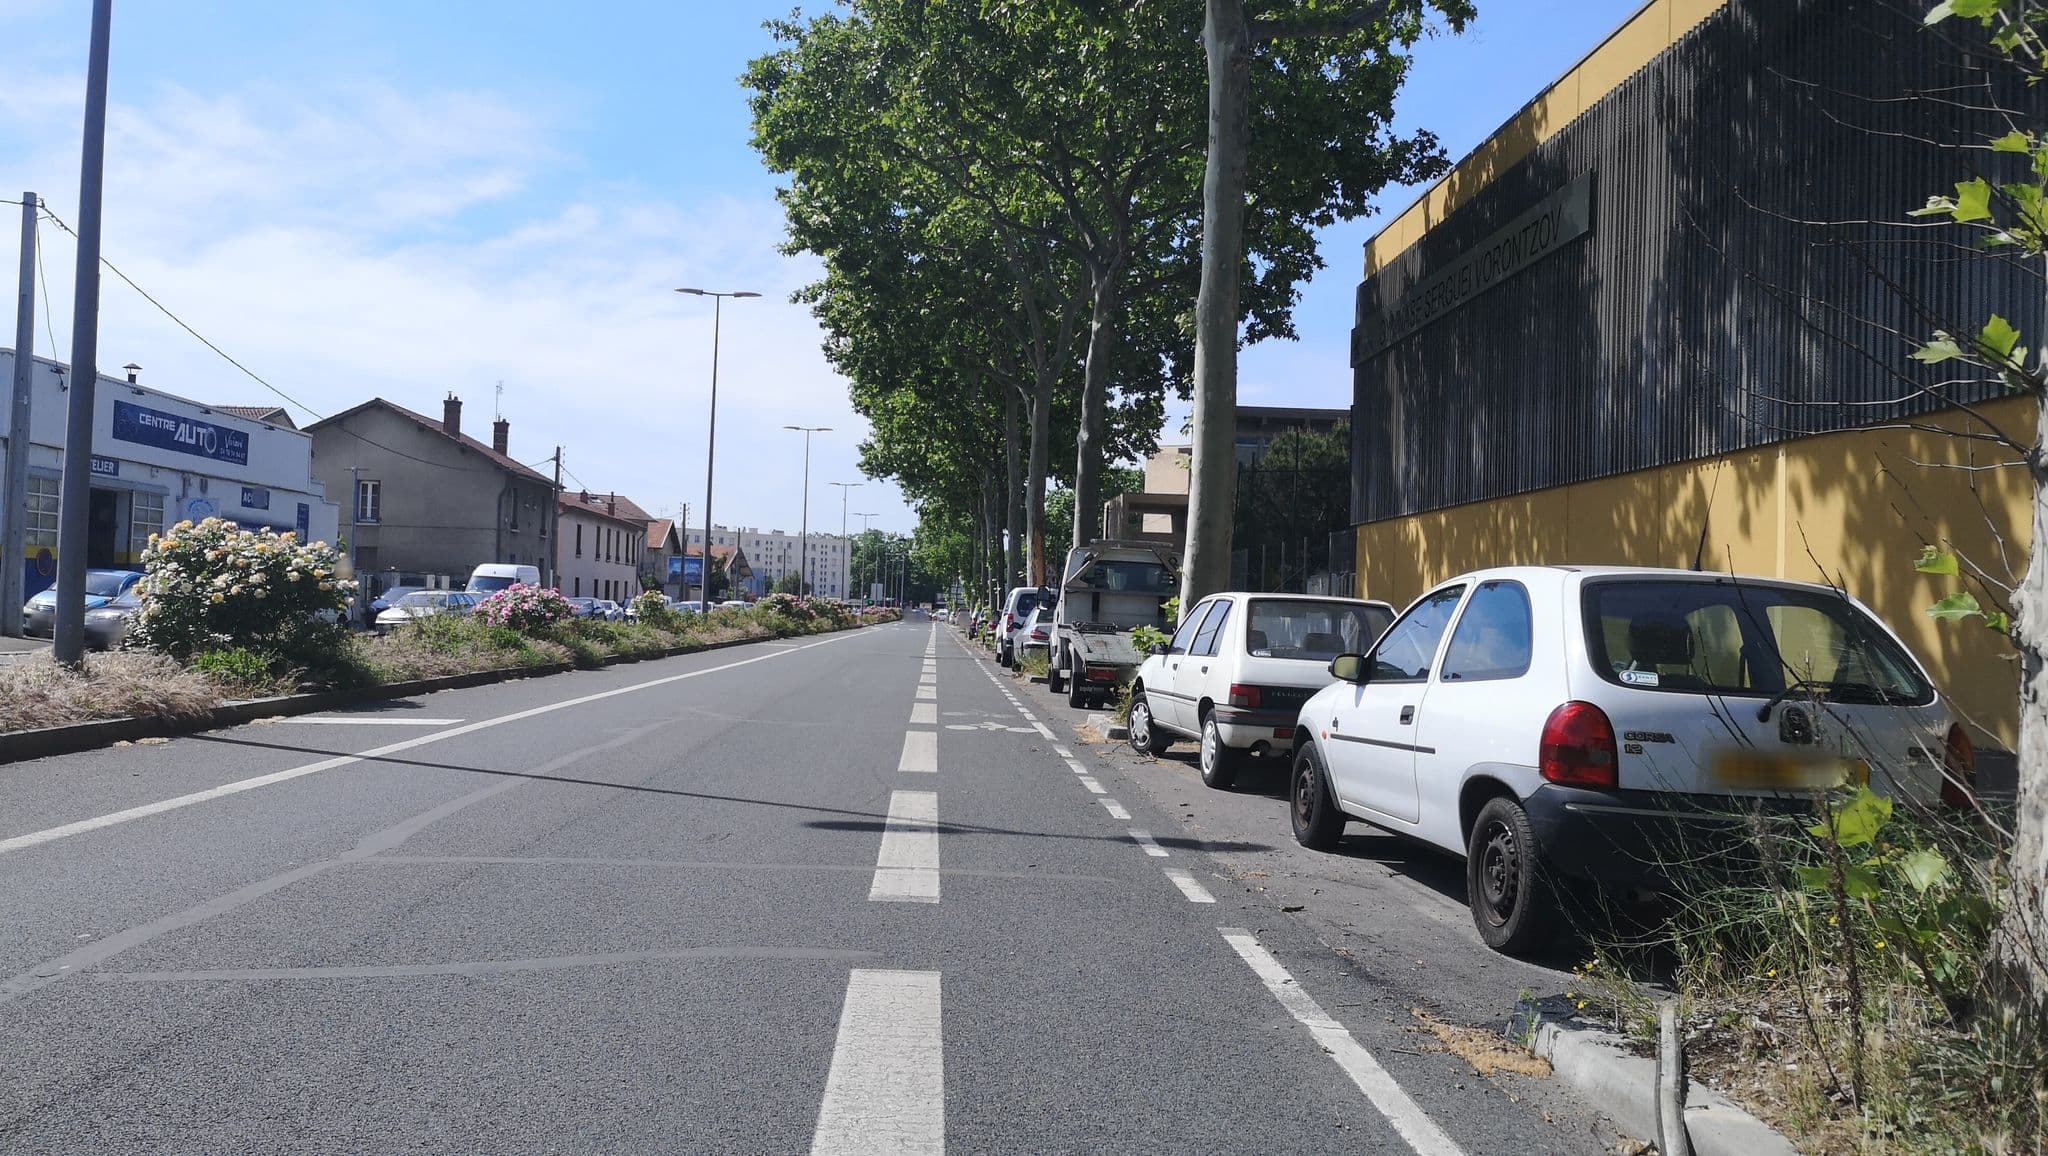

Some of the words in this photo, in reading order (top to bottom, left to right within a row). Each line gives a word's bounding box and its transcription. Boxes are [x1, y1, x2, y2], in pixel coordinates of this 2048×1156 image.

[1474, 205, 1562, 286] VORONTZOV
[139, 413, 176, 431] CENTRE
[174, 422, 217, 454] AUTO
[1624, 731, 1676, 744] CORSA
